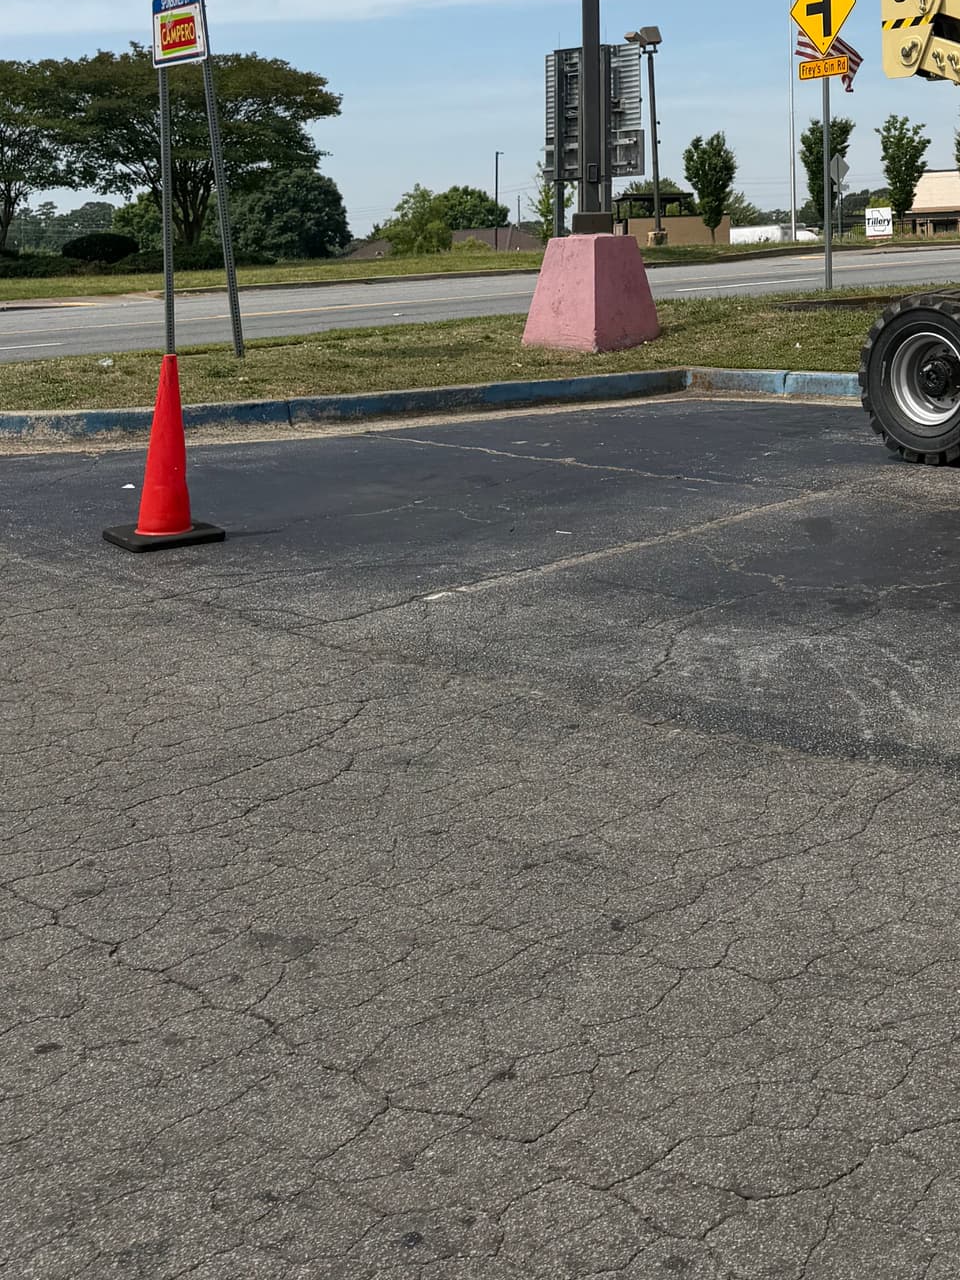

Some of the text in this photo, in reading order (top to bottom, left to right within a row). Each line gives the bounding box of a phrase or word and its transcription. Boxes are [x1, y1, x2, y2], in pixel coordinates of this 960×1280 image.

[162, 22, 195, 45] CAMPERO
[802, 59, 846, 77] Frey's Gin Rd
